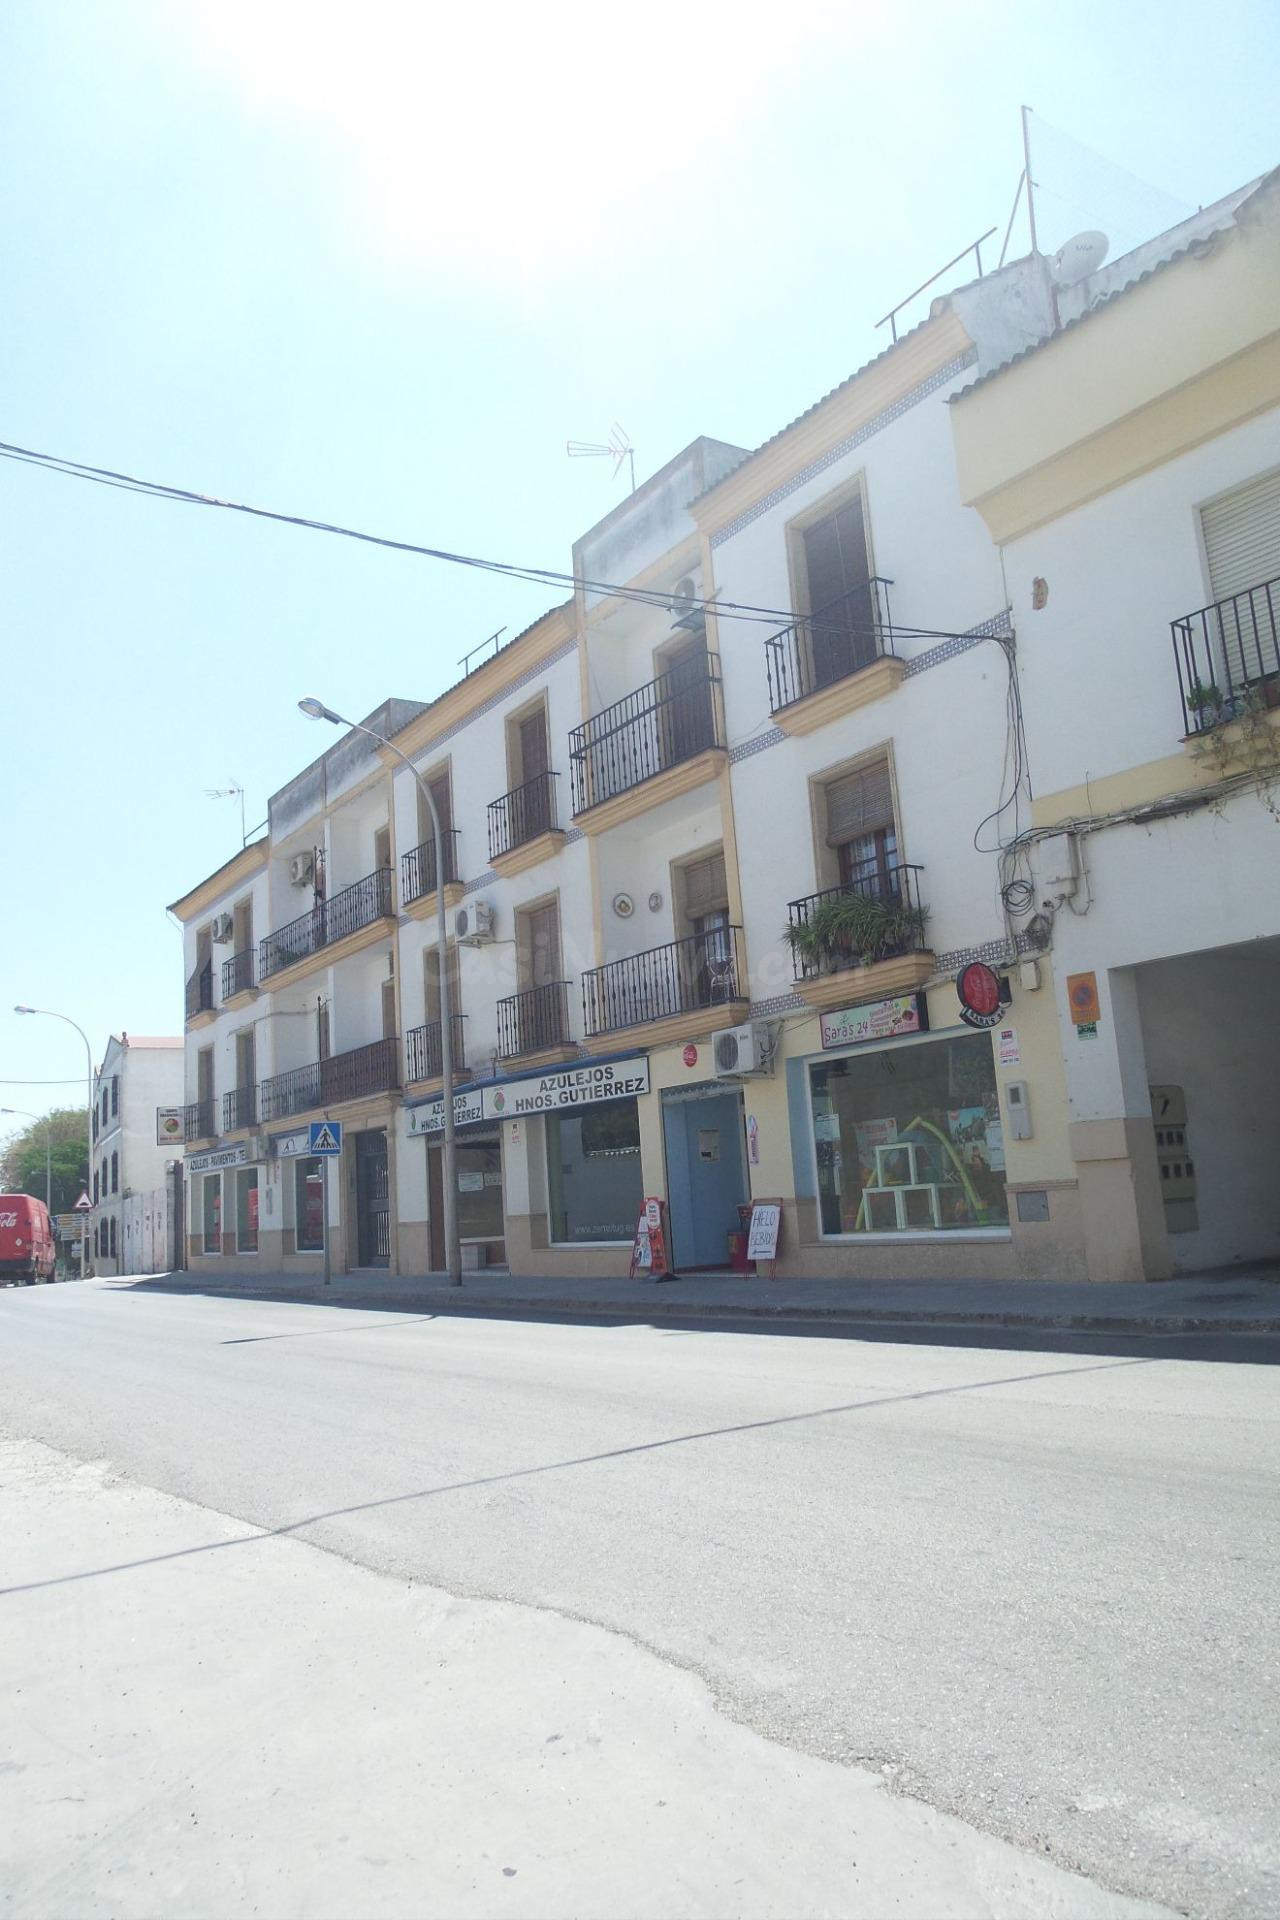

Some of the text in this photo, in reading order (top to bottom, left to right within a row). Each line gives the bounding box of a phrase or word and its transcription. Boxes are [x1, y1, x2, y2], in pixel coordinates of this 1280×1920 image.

[824, 1025, 854, 1041] Sara's
[857, 1020, 868, 1034] 24
[539, 1067, 614, 1093] AZULEJOS
[515, 1077, 645, 1111] HNOS. GUTIERREZ
[432, 1097, 467, 1115] AZUJOS
[421, 1107, 481, 1131] HNOS. GIERREZ
[190, 1158, 208, 1171] AZULEJOS
[211, 1152, 236, 1167] PAVIMENTOS
